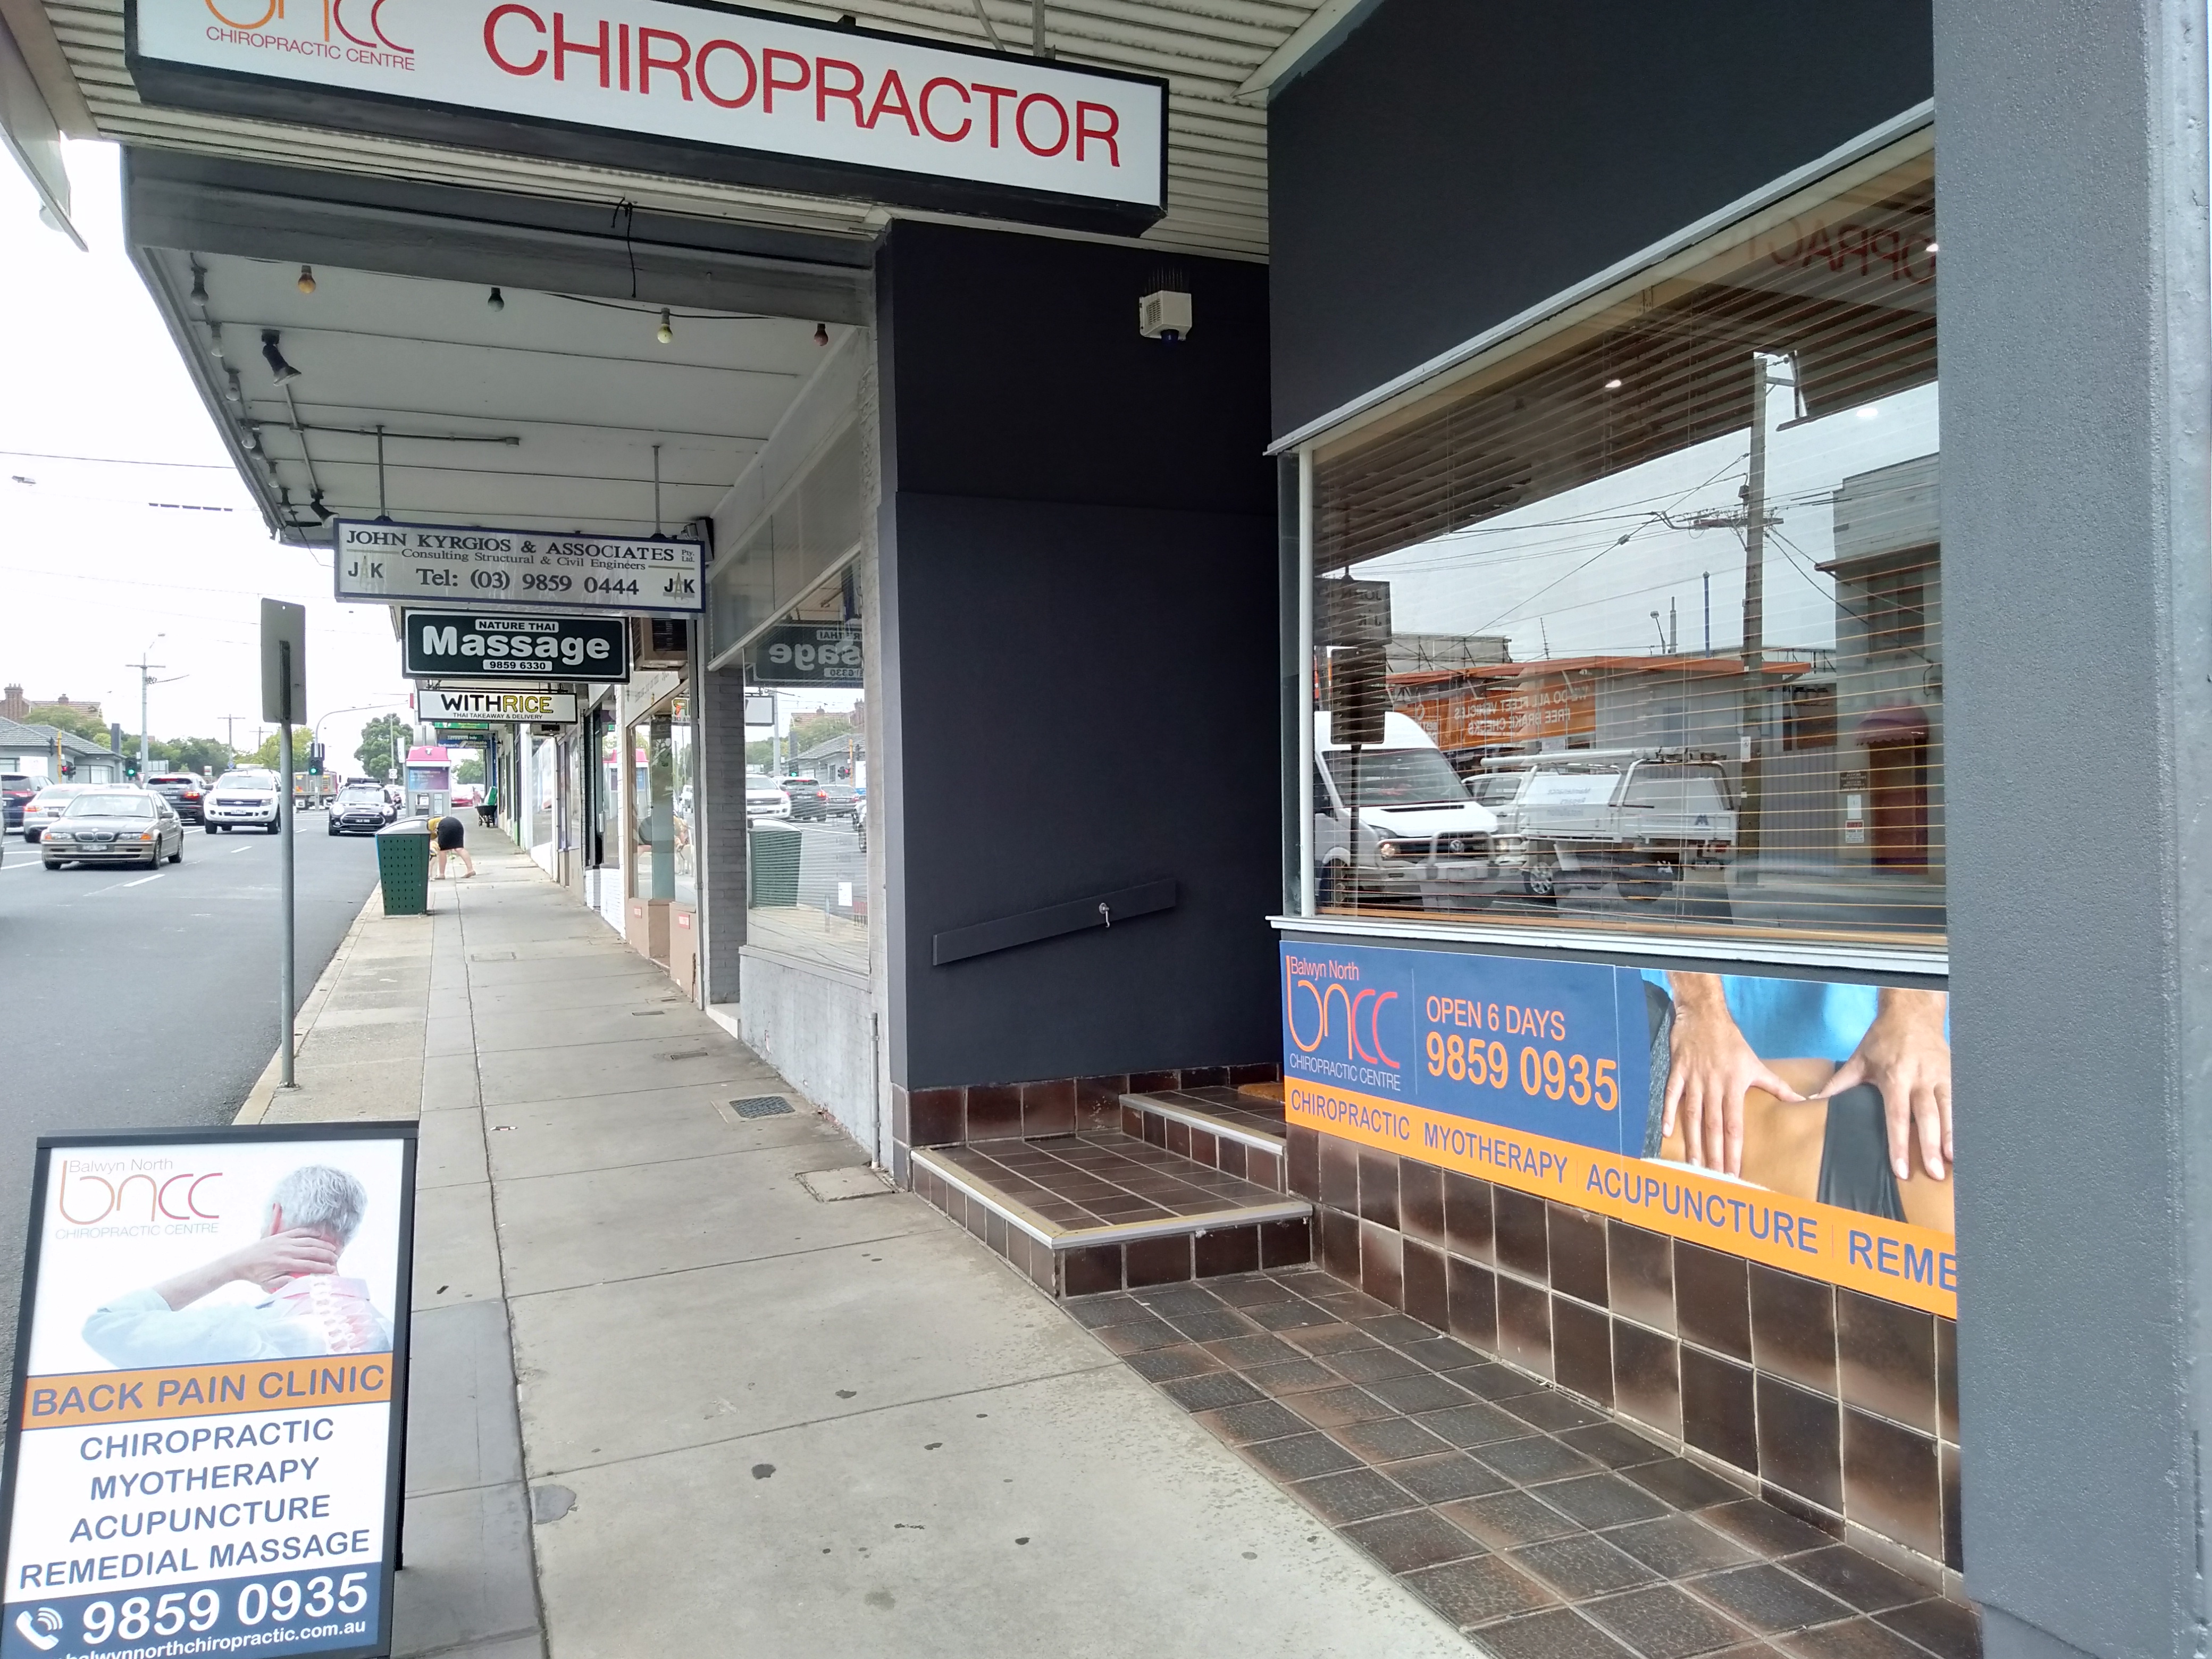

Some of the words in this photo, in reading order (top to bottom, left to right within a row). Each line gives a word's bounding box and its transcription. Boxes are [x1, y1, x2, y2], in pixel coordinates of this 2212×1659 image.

[206, 26, 341, 60] CHIROPRACTIC
[346, 48, 415, 71] CENTRE
[483, 4, 1121, 167] CHIROPRACTOR
[347, 530, 407, 546] JOHN
[417, 534, 511, 552] KYRGIOS
[521, 540, 537, 554] &
[546, 542, 674, 561] ASSOCIATES
[401, 548, 469, 562] Consulting
[475, 552, 534, 564] Structural
[540, 556, 551, 565] &
[557, 556, 584, 567] Civil
[590, 559, 646, 570] Engineers
[416, 567, 458, 586] Tel:
[470, 568, 510, 590] (03)
[522, 573, 572, 592] 9859
[584, 576, 640, 595] 0444
[423, 625, 610, 665] Massage
[479, 621, 525, 630] NATURE
[531, 622, 556, 631] THAI
[490, 661, 516, 669] 9859
[1291, 956, 1327, 981] Balwyn
[1329, 960, 1360, 981] North
[1426, 996, 1482, 1028] OPEN
[1487, 1008, 1500, 1032] 6
[1505, 1006, 1566, 1041] DAYS
[1289, 1053, 1357, 1082] CHIROPRACTIC
[1359, 1067, 1401, 1092] CENTRE
[1426, 1032, 1508, 1090] 9859
[1520, 1046, 1618, 1111] 0935
[1291, 1088, 1410, 1141] CHIROPRACTIC
[69, 1160, 125, 1175] Balwyn
[131, 1158, 173, 1171] North
[1424, 1122, 1568, 1184] MYOTHERAPY
[1586, 1163, 1819, 1254] ACUPUNCTURE
[55, 1225, 161, 1240] CHIROPRACTIC
[165, 1222, 219, 1235] CENTRE
[31, 1381, 144, 1417] BACK
[157, 1375, 246, 1407] PAIN
[258, 1364, 385, 1398] CLINIC
[80, 1418, 334, 1461] CHIROPRACTIC
[90, 1457, 320, 1500] MYOTHERAPY
[69, 1495, 331, 1543] ACUPUNCTURE
[20, 1548, 199, 1589] REMEDIAL
[210, 1529, 371, 1568] MASSAGE
[82, 1588, 221, 1644] 9859
[237, 1572, 368, 1626] 0935
